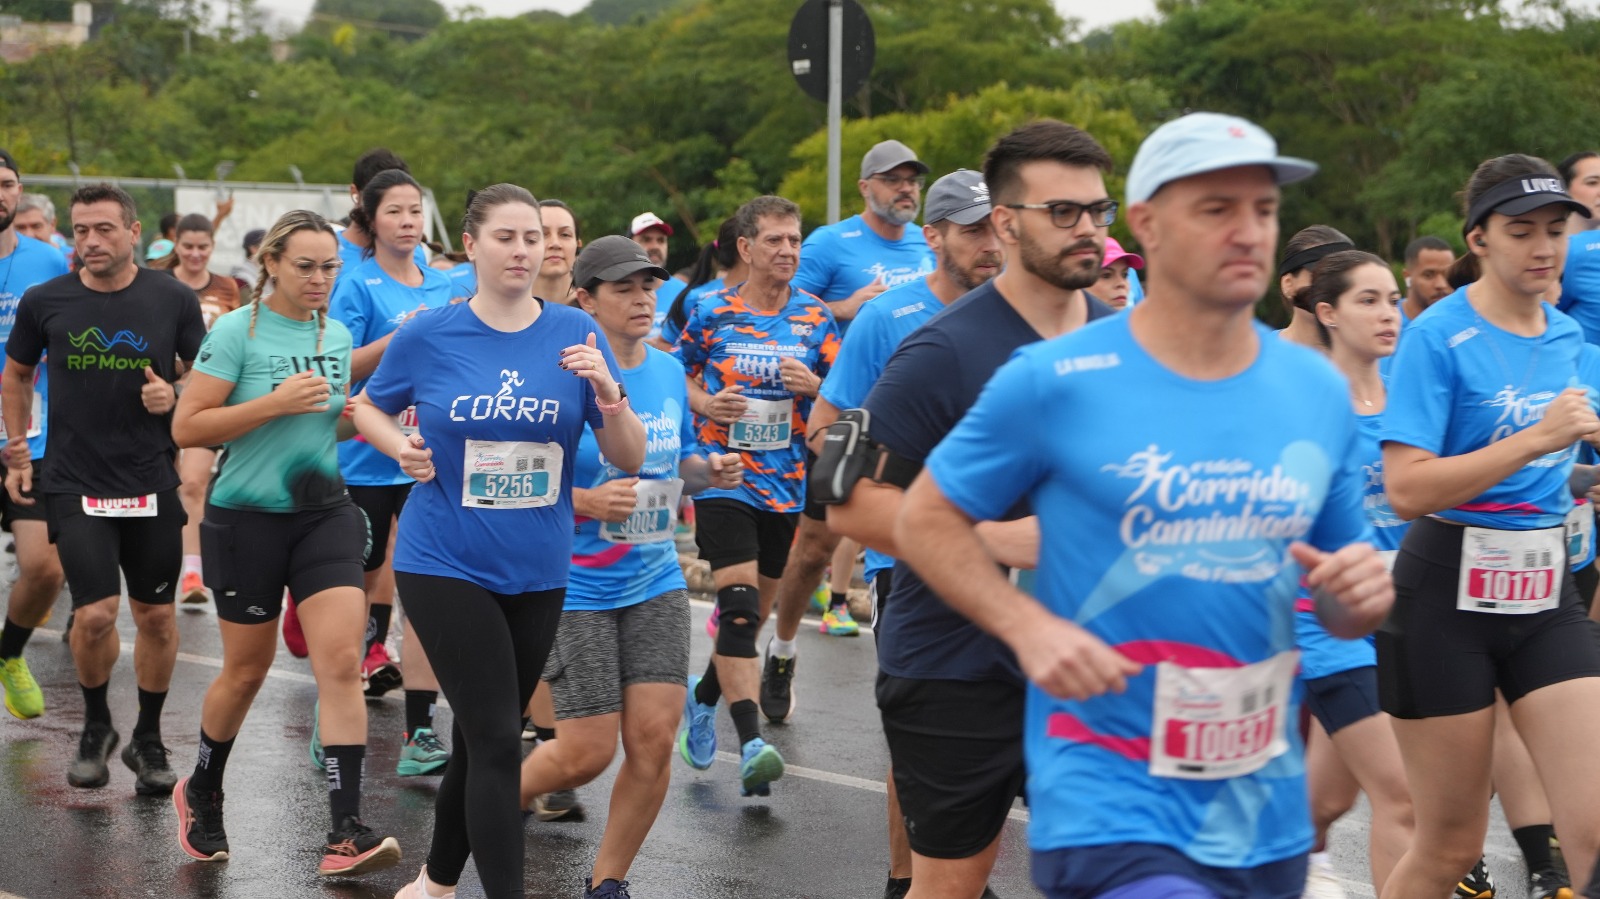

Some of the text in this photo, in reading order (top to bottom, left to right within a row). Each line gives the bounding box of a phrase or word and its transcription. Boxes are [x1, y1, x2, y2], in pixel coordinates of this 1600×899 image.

[67, 354, 152, 370] RP Move
[450, 394, 560, 425] CORRA
[744, 424, 779, 442] 5343
[484, 473, 533, 498] 5256
[1157, 464, 1299, 512] Corrida
[1479, 570, 1550, 600] 10170
